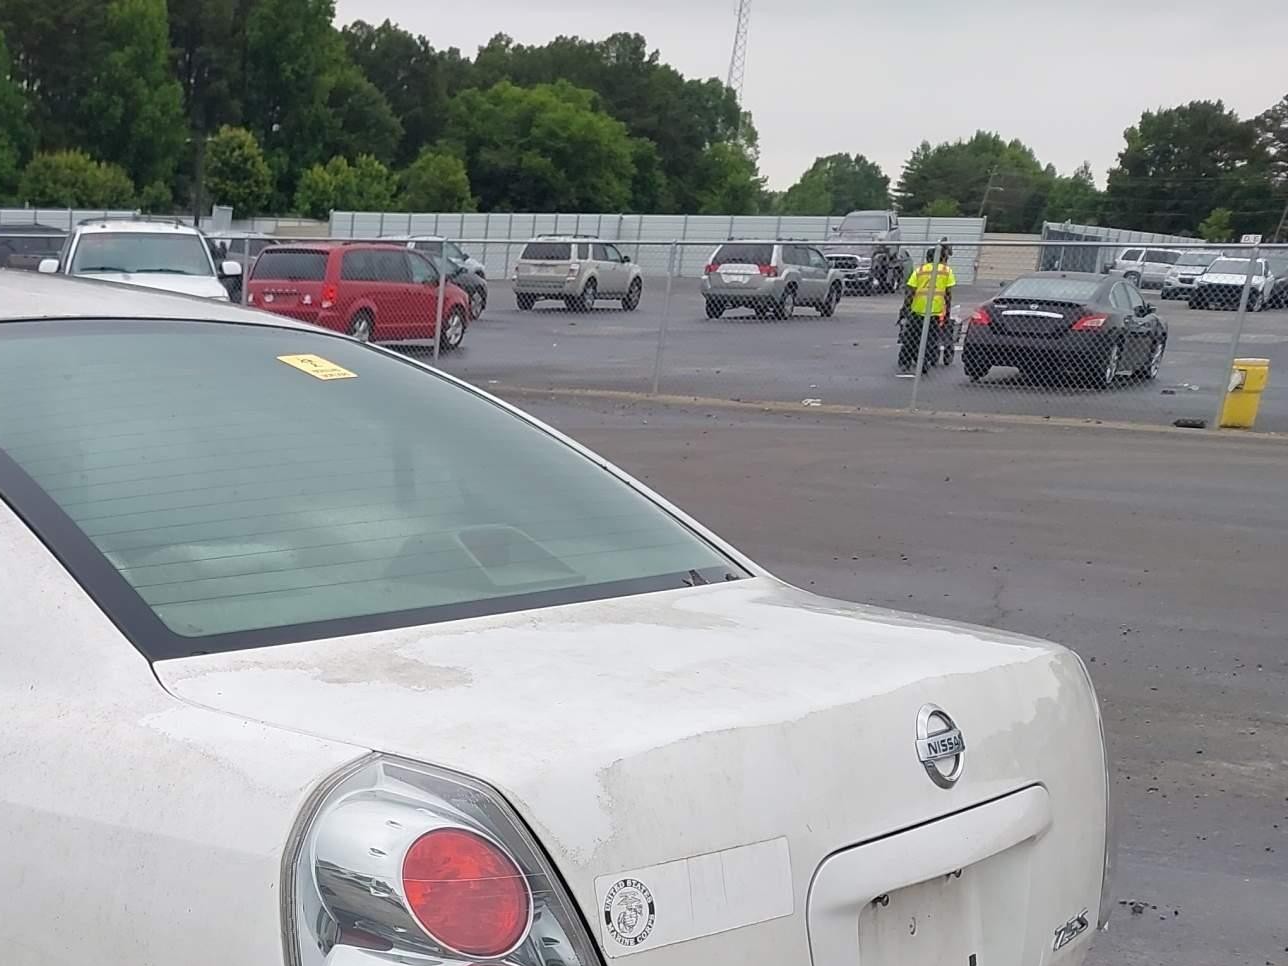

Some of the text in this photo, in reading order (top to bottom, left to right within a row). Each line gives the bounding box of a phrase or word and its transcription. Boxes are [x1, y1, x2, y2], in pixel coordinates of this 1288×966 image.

[605, 879, 653, 911] UNITED STATES
[607, 914, 655, 946] MARINE CORPS
